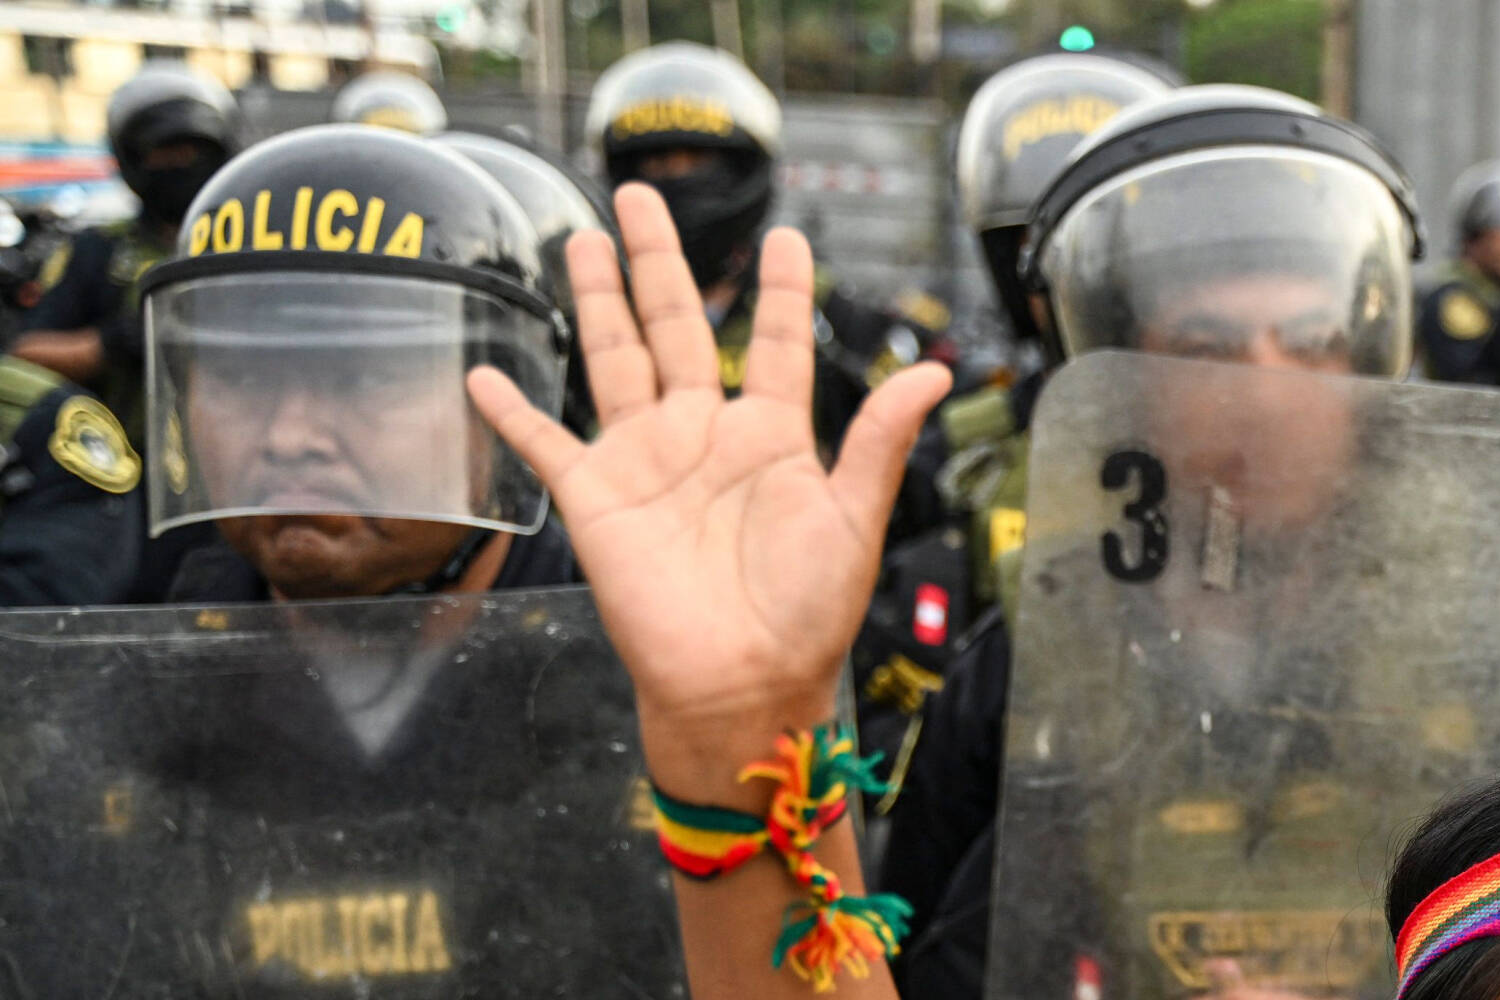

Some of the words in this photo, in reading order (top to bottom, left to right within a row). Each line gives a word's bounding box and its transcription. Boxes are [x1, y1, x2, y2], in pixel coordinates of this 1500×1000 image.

[188, 186, 424, 259] POLICIA
[1101, 449, 1167, 584] 3
[248, 890, 452, 977] POLICIA
